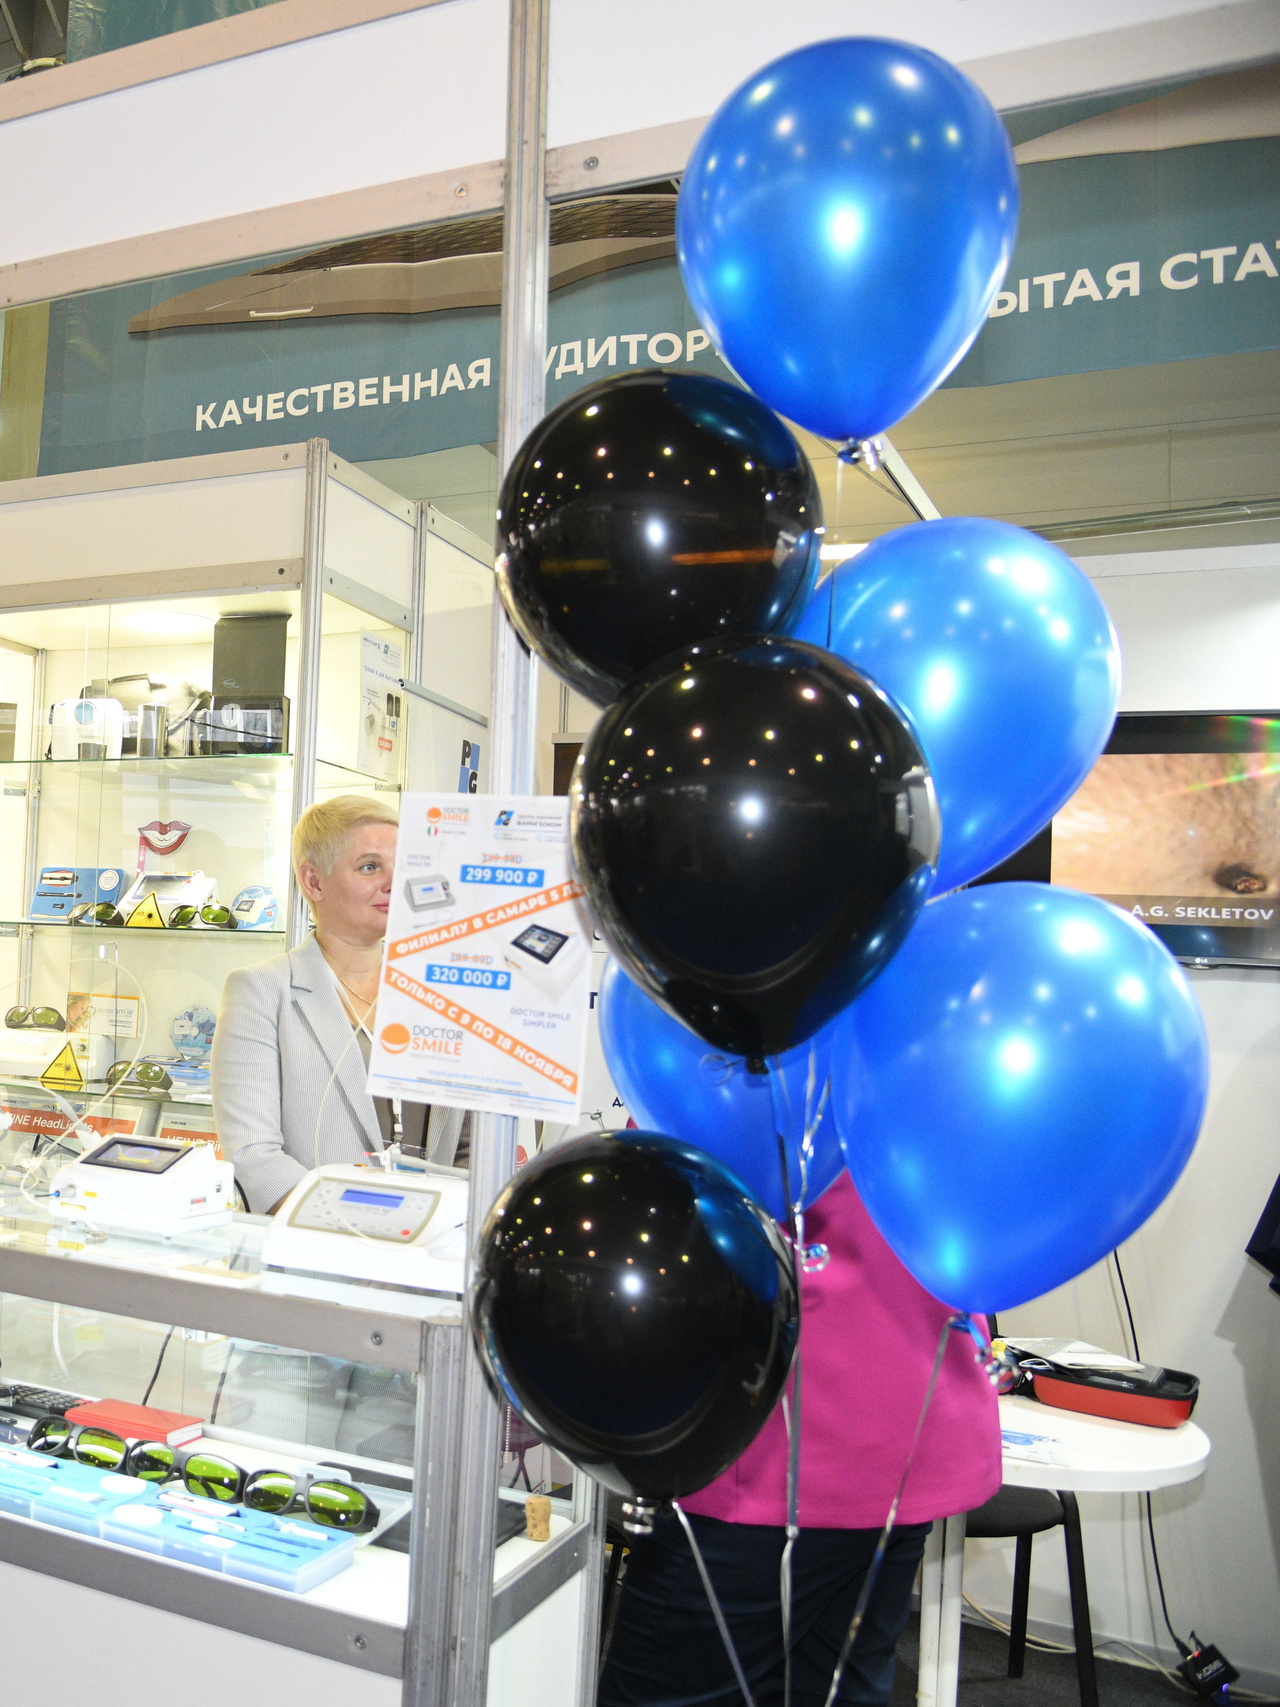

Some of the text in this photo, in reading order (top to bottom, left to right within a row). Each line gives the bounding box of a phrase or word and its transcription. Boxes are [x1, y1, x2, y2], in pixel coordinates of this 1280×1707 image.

[194, 240, 1280, 433] КАЧЕСТВЕННАЯ УДИТОР ЫТАЯ СТА
[442, 814, 469, 822] SMILE
[443, 807, 469, 815] DOCTOR
[465, 867, 492, 881] 299
[495, 869, 524, 884] 900
[1130, 905, 1274, 920] A.G. SEKLETOV
[396, 921, 468, 954] ФИЛИАЛУ
[472, 917, 483, 929] В
[486, 893, 548, 924] САМАРЕ
[550, 889, 559, 901] 5
[431, 967, 459, 982] 320
[462, 970, 493, 986] 000
[510, 1007, 571, 1021] DOCTOR SMILE
[389, 971, 446, 1010] ТОЛЬКО
[460, 1013, 470, 1025] 9
[472, 1021, 494, 1039] ПО
[497, 1034, 512, 1050] 18
[513, 1045, 574, 1087] НОЯБРЯ
[522, 1019, 557, 1030] SIMPLER
[413, 1025, 463, 1041] DOCTOR
[412, 1037, 463, 1056] SMILE
